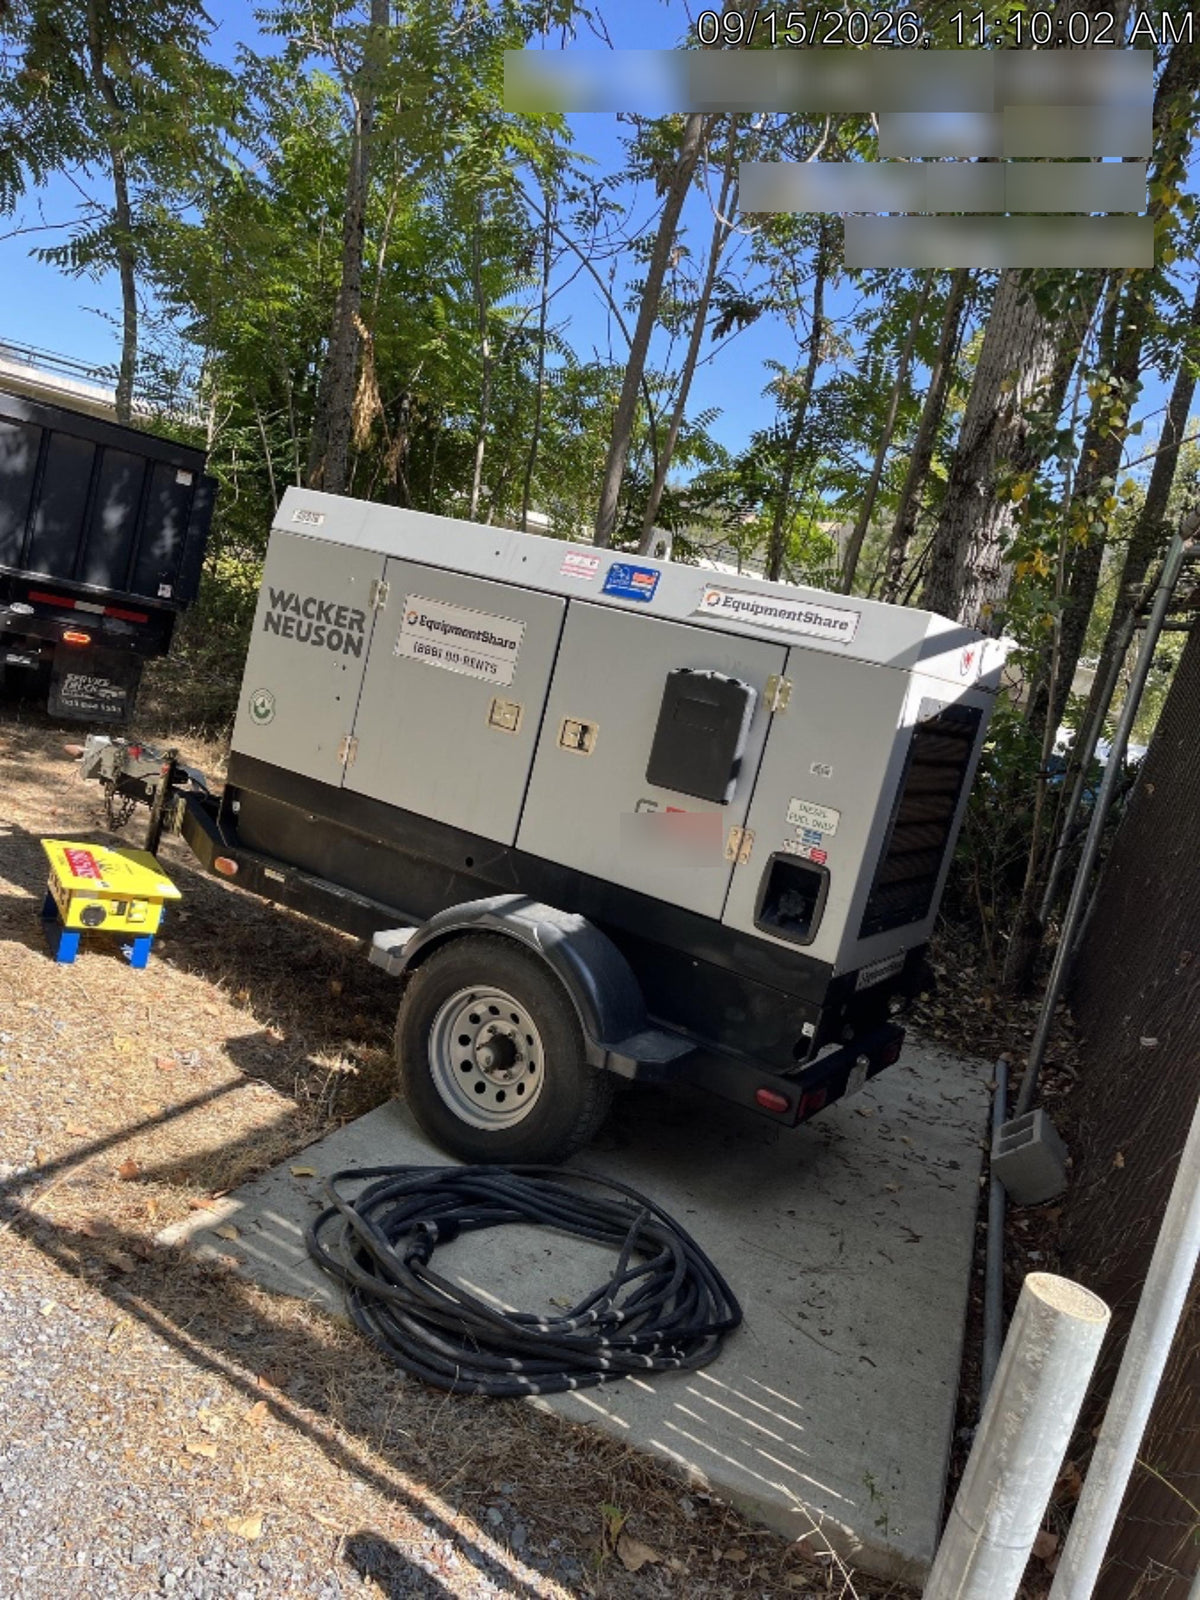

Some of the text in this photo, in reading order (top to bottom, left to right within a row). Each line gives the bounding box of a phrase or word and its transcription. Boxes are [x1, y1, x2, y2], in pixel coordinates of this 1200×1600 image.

[268, 586, 366, 634] WACKER
[721, 595, 849, 630] EquipmentShare
[263, 611, 364, 658] NEUSON
[419, 614, 517, 650] EquipmentShare
